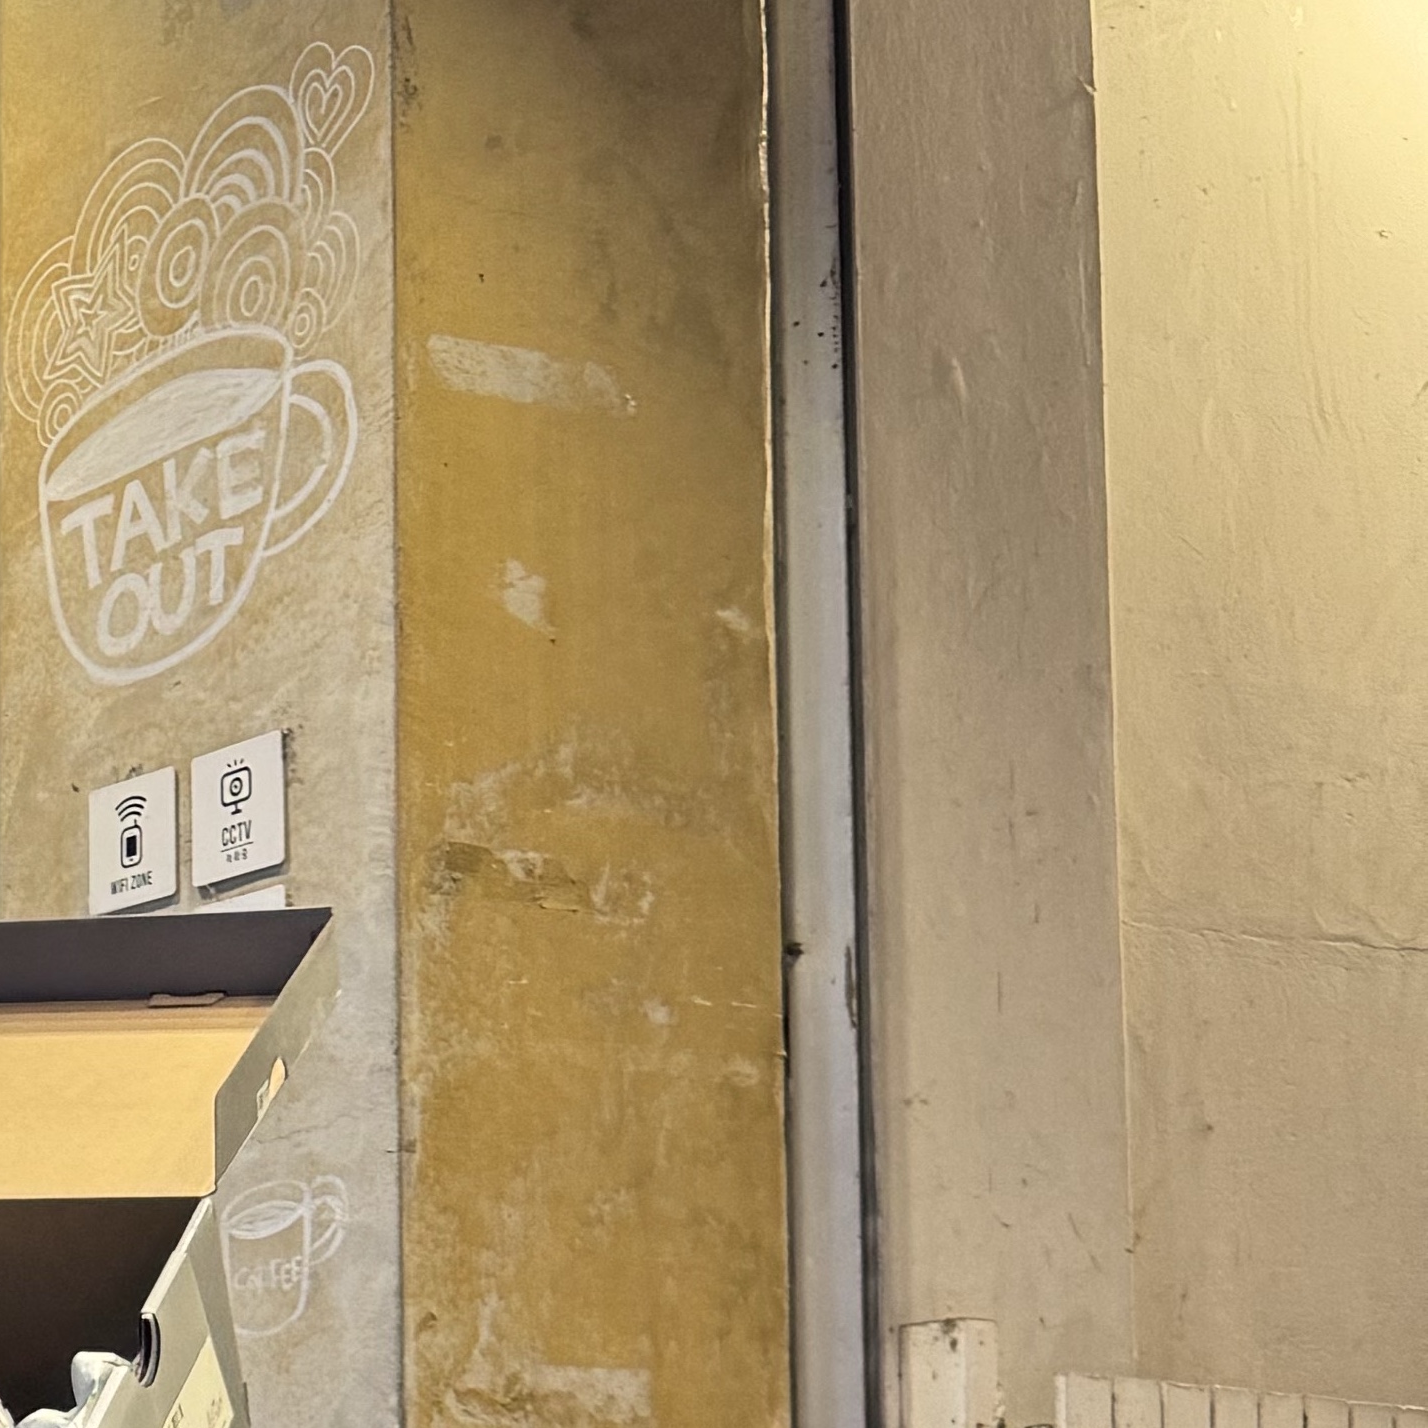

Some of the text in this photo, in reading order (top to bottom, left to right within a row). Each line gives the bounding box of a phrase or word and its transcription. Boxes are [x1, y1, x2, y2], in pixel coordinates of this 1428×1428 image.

[60, 426, 266, 589] TAKE
[97, 526, 244, 656] OUT
[221, 819, 253, 847] CCTV
[111, 870, 153, 894] WIFI ZONE
